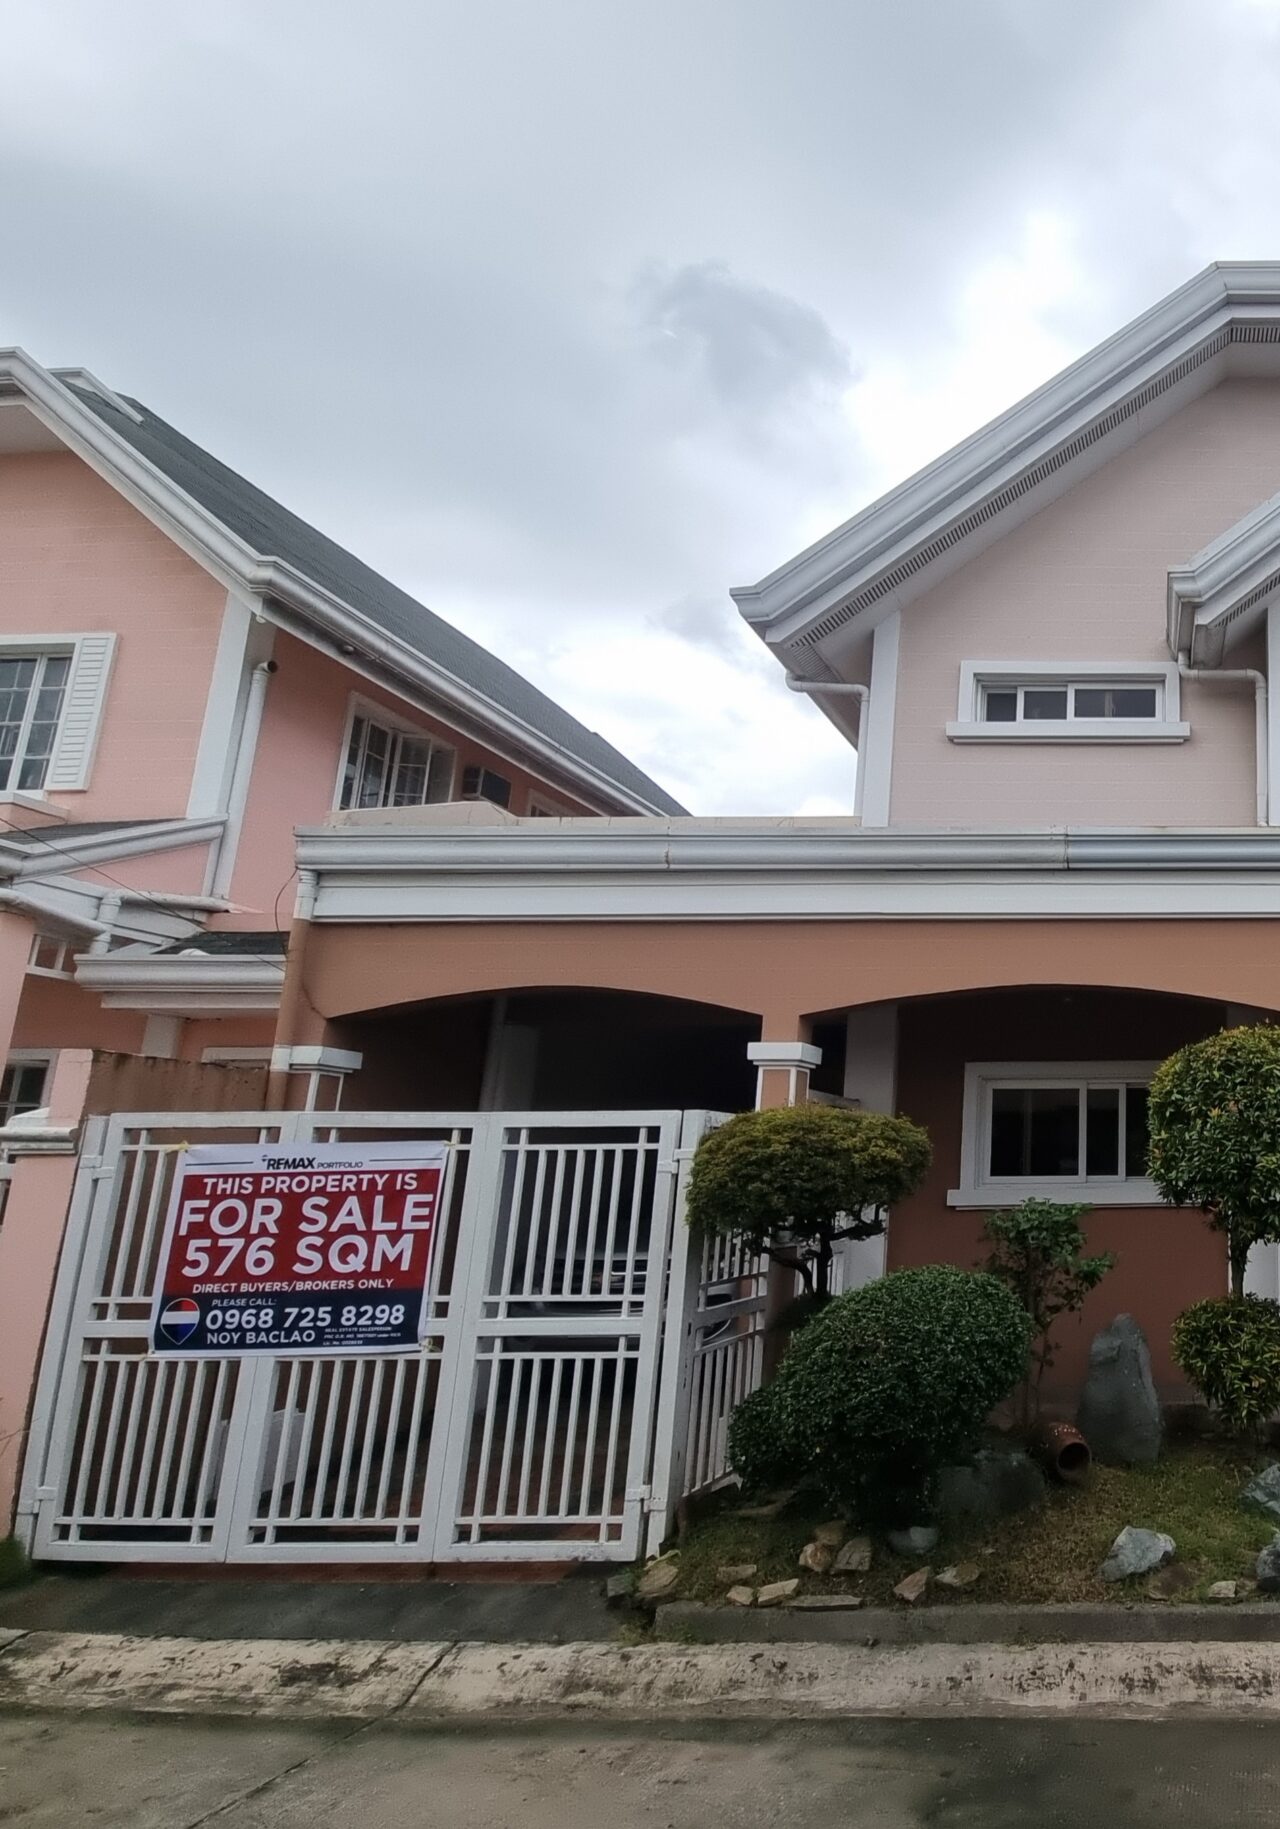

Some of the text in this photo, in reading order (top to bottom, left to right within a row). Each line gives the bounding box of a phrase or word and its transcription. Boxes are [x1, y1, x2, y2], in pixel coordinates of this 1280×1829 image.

[317, 1161, 363, 1169] PORTFOLIO
[203, 1173, 418, 1195] THIS PROPERTY IS
[178, 1194, 434, 1236] FOR SALE
[181, 1233, 414, 1277] 576 SQM
[192, 1278, 394, 1294] DIRECT BUYERS/BROKERS ONLY
[211, 1298, 247, 1307] PLEASE
[205, 1304, 405, 1330] 0968 725 8298
[207, 1330, 316, 1345] NOY BACLAO
